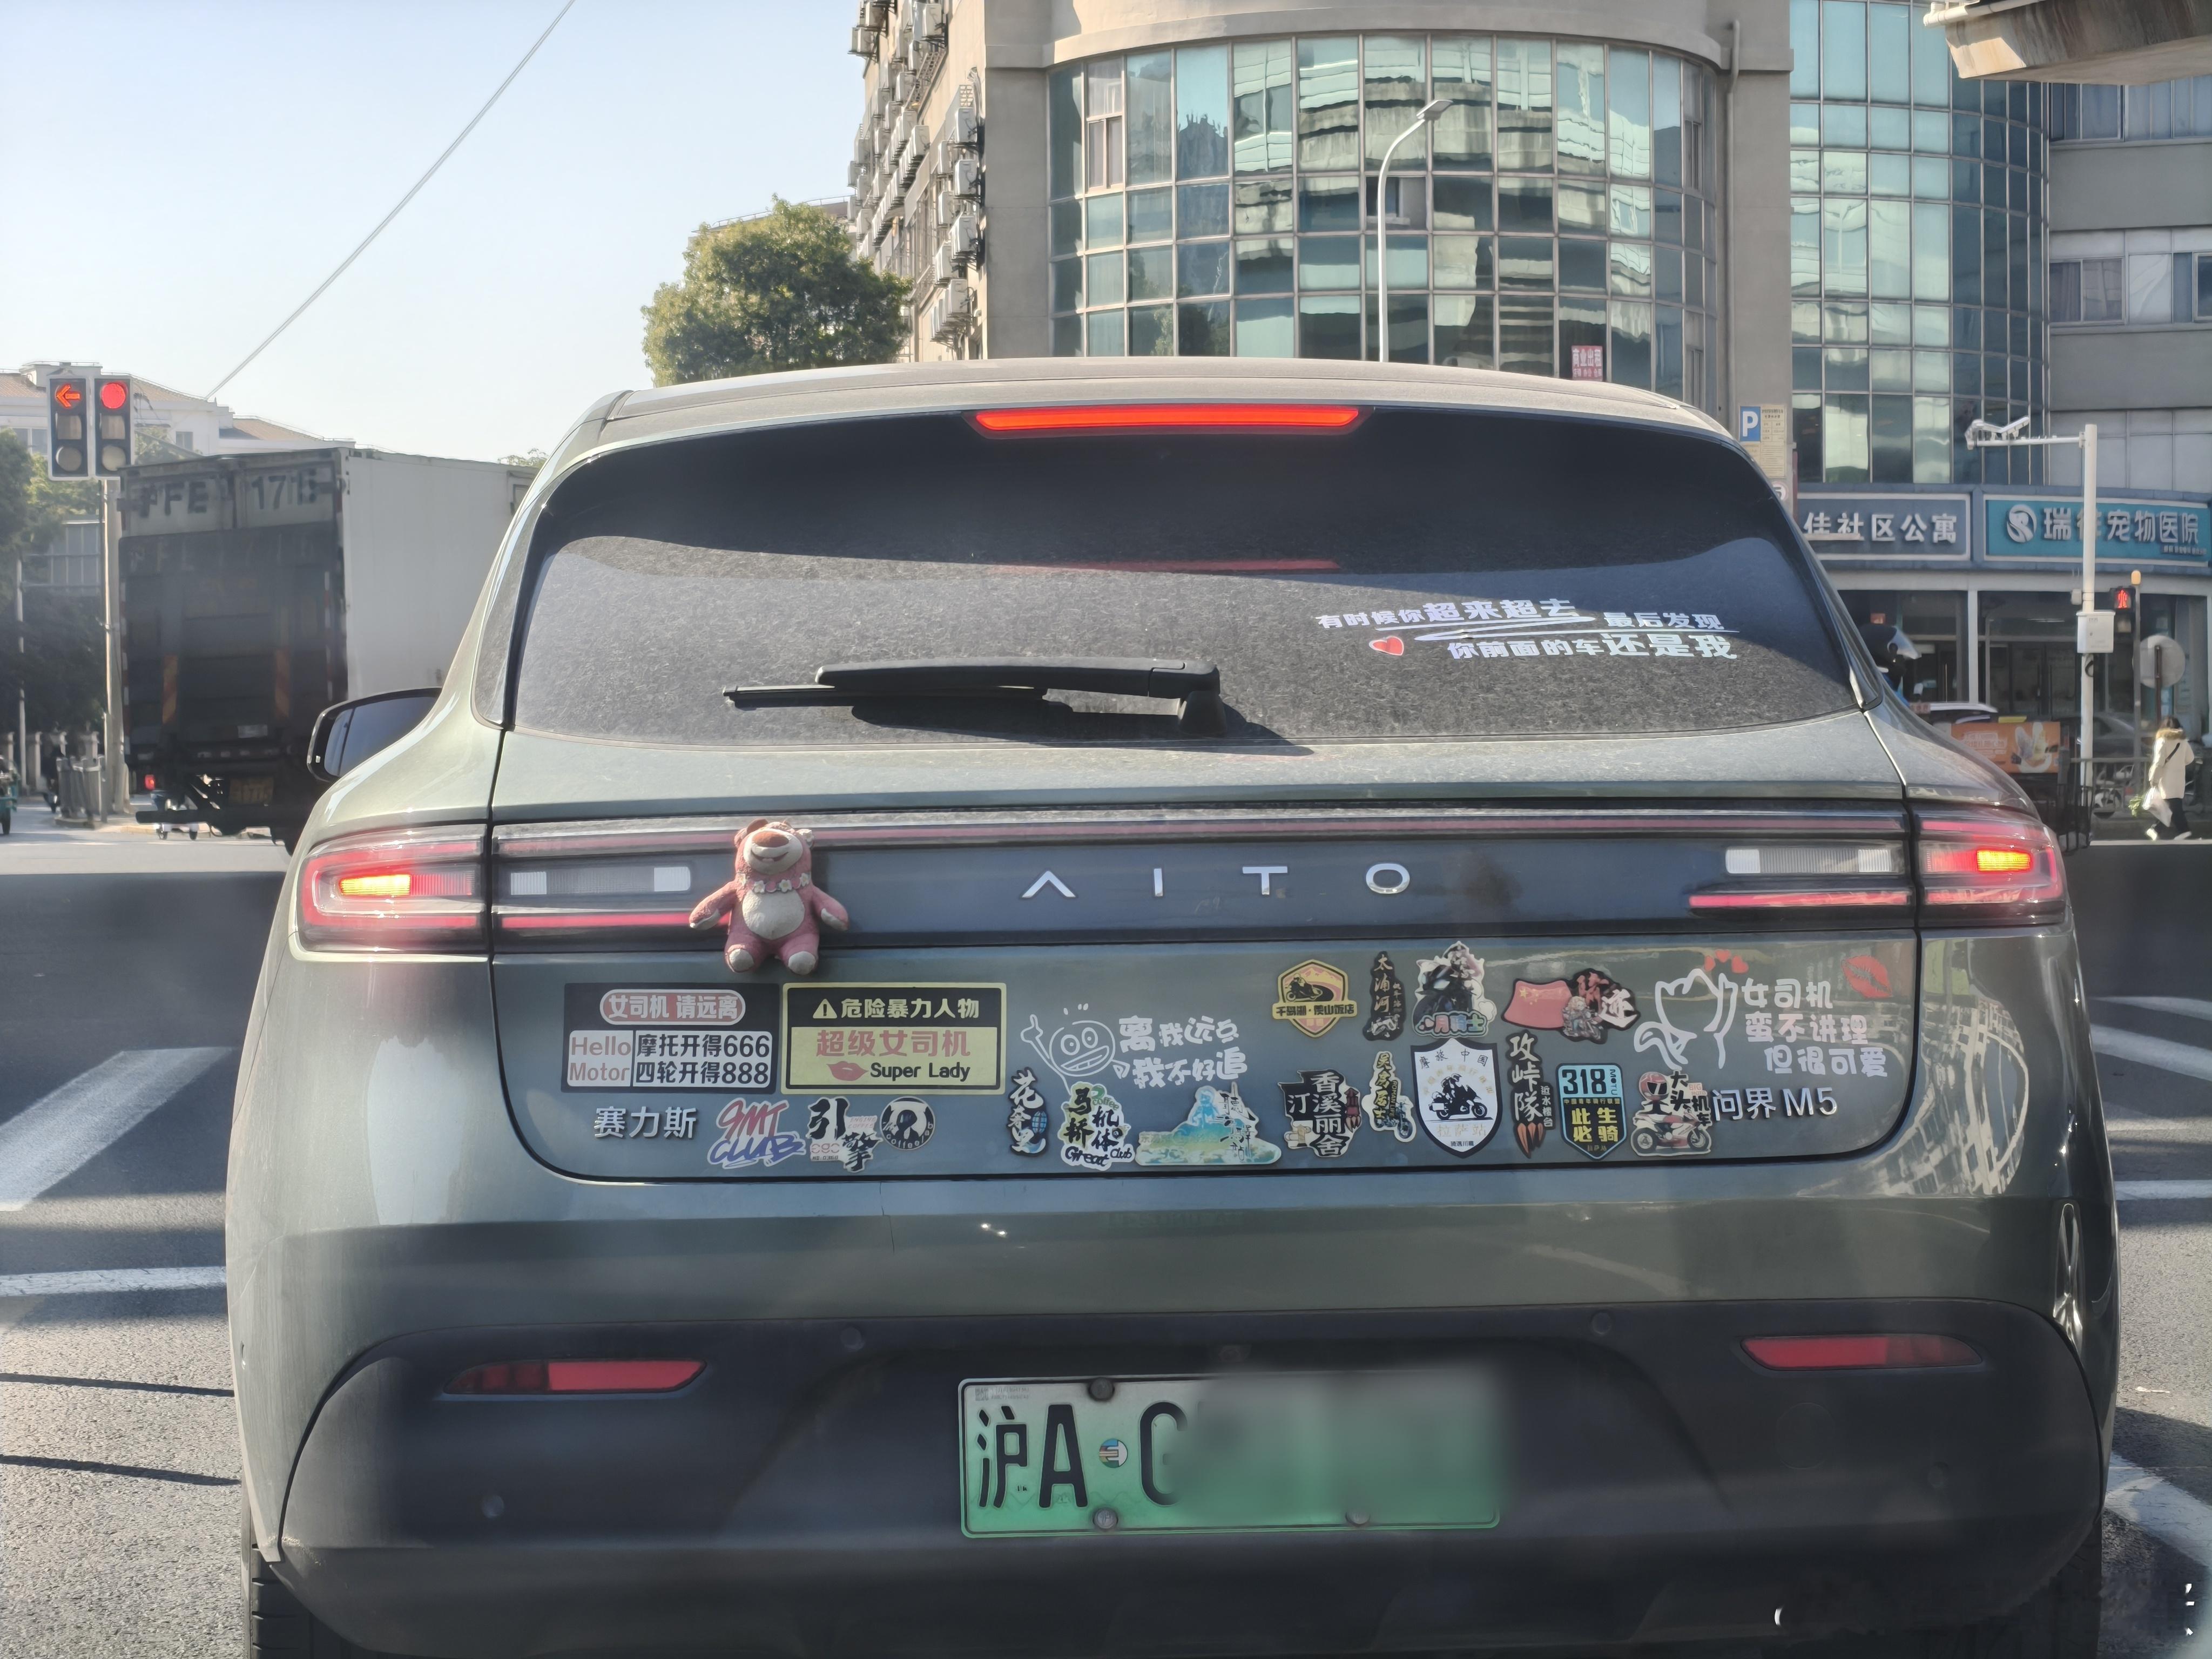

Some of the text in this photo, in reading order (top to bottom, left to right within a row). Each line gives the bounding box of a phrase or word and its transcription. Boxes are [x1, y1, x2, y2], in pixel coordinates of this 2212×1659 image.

[1743, 411, 1758, 437] P
[1316, 598, 1724, 630] 有时候你超来超去 最后发现
[1447, 633, 1737, 659] 你前面的车还是我
[1022, 863, 1410, 898] AITO
[1742, 977, 1833, 1009] 女司机
[609, 995, 738, 1019] 女司机 请远离
[841, 998, 979, 1019] 危险暴力人物
[1119, 1015, 1239, 1053] 离我远点
[1745, 1011, 1868, 1044] 蛮不讲理
[571, 1036, 631, 1056] Hello
[637, 1034, 770, 1057] 摩托开得666
[816, 1029, 970, 1057] 超级女司机
[570, 1062, 630, 1081] Motor
[636, 1061, 768, 1084] 四轮开得888
[870, 1062, 970, 1082] Super Lady
[1132, 1047, 1247, 1089] 我不好追
[1764, 1044, 1887, 1077] 但很可爱
[1562, 1069, 1607, 1094] 318
[1712, 1087, 1837, 1121] 问界 M5
[594, 1106, 696, 1139] 赛力斯
